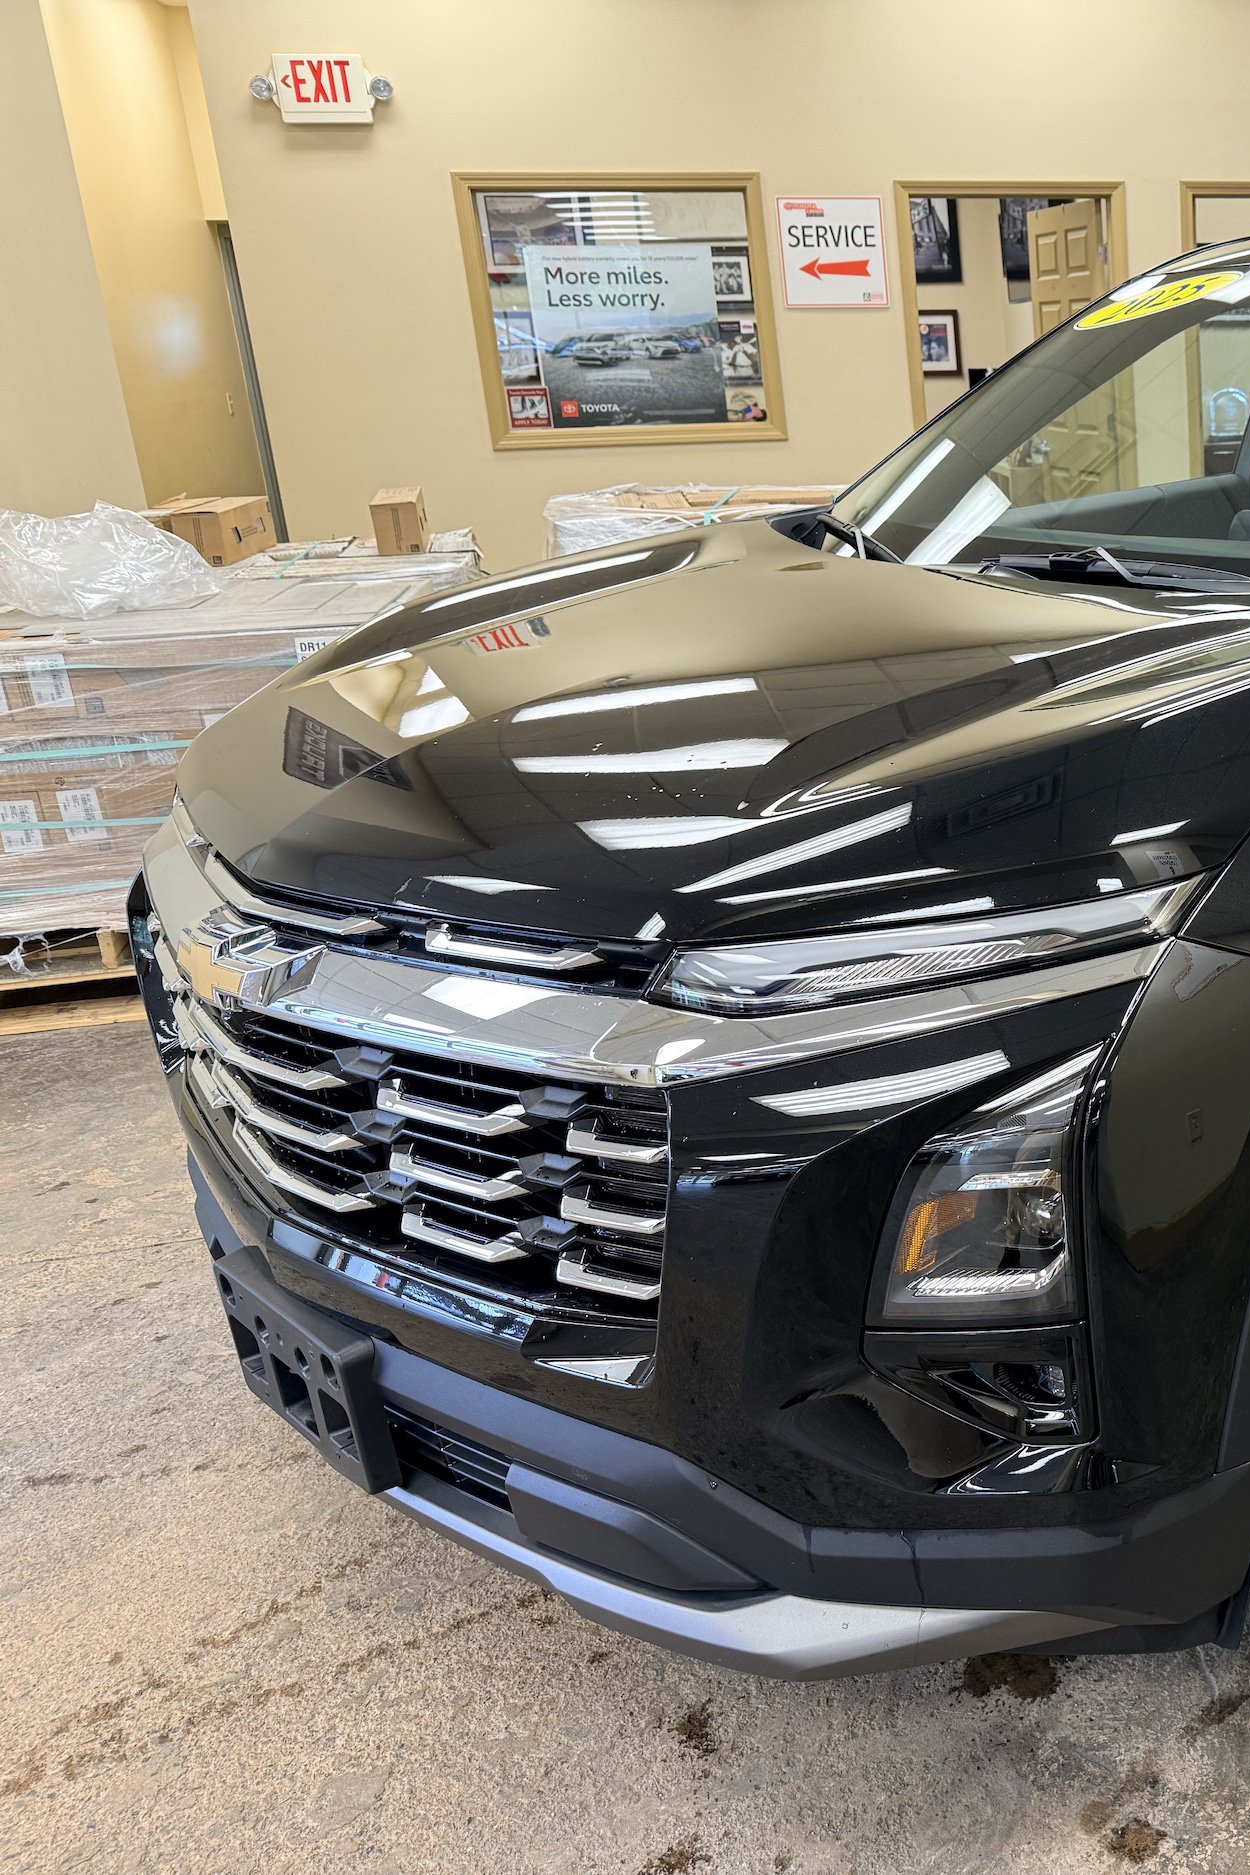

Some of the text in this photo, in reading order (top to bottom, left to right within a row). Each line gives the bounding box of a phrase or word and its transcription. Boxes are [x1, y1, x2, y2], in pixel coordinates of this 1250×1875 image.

[289, 60, 351, 103] EXIT
[788, 225, 876, 247] SERVICE
[543, 265, 669, 285] More miles.
[547, 289, 665, 311] Less worry.
[1093, 275, 1222, 324] 2025
[581, 404, 620, 413] TOYOTA
